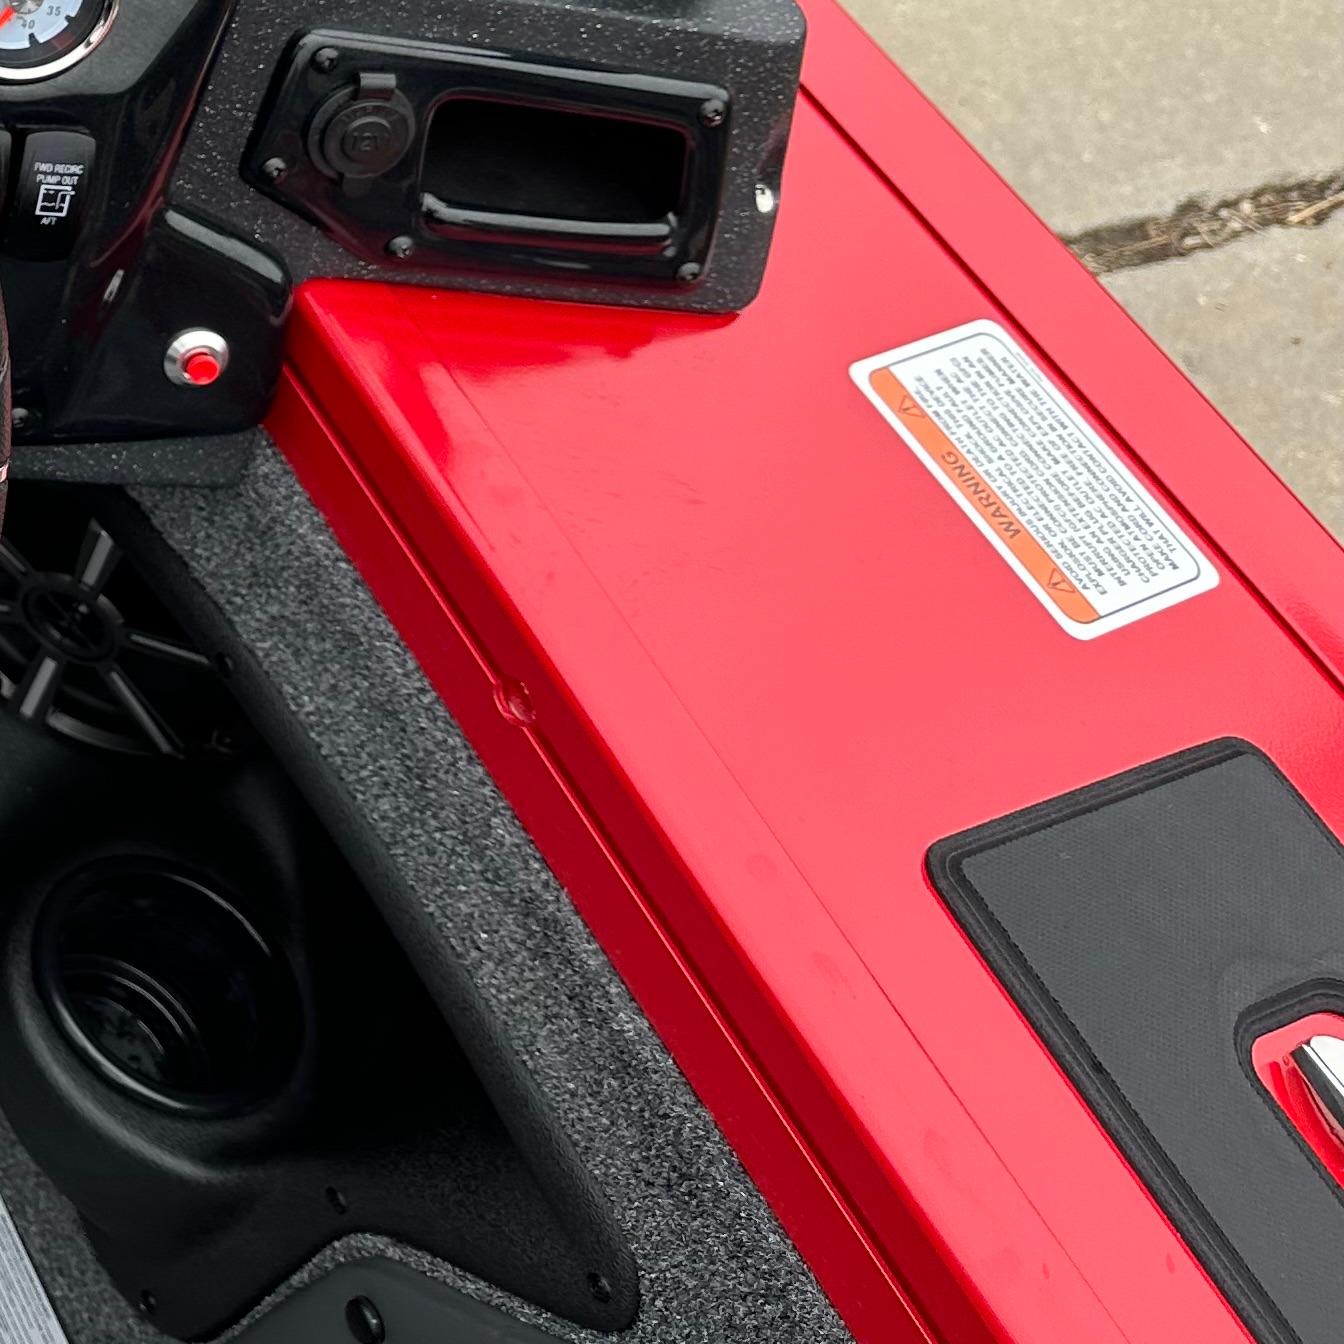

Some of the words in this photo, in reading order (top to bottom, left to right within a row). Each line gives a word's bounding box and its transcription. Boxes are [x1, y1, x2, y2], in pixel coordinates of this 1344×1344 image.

[46, 6, 61, 16] 35
[36, 174, 61, 185] PUMP
[61, 175, 79, 185] OUT
[938, 449, 1024, 539] WARNING
